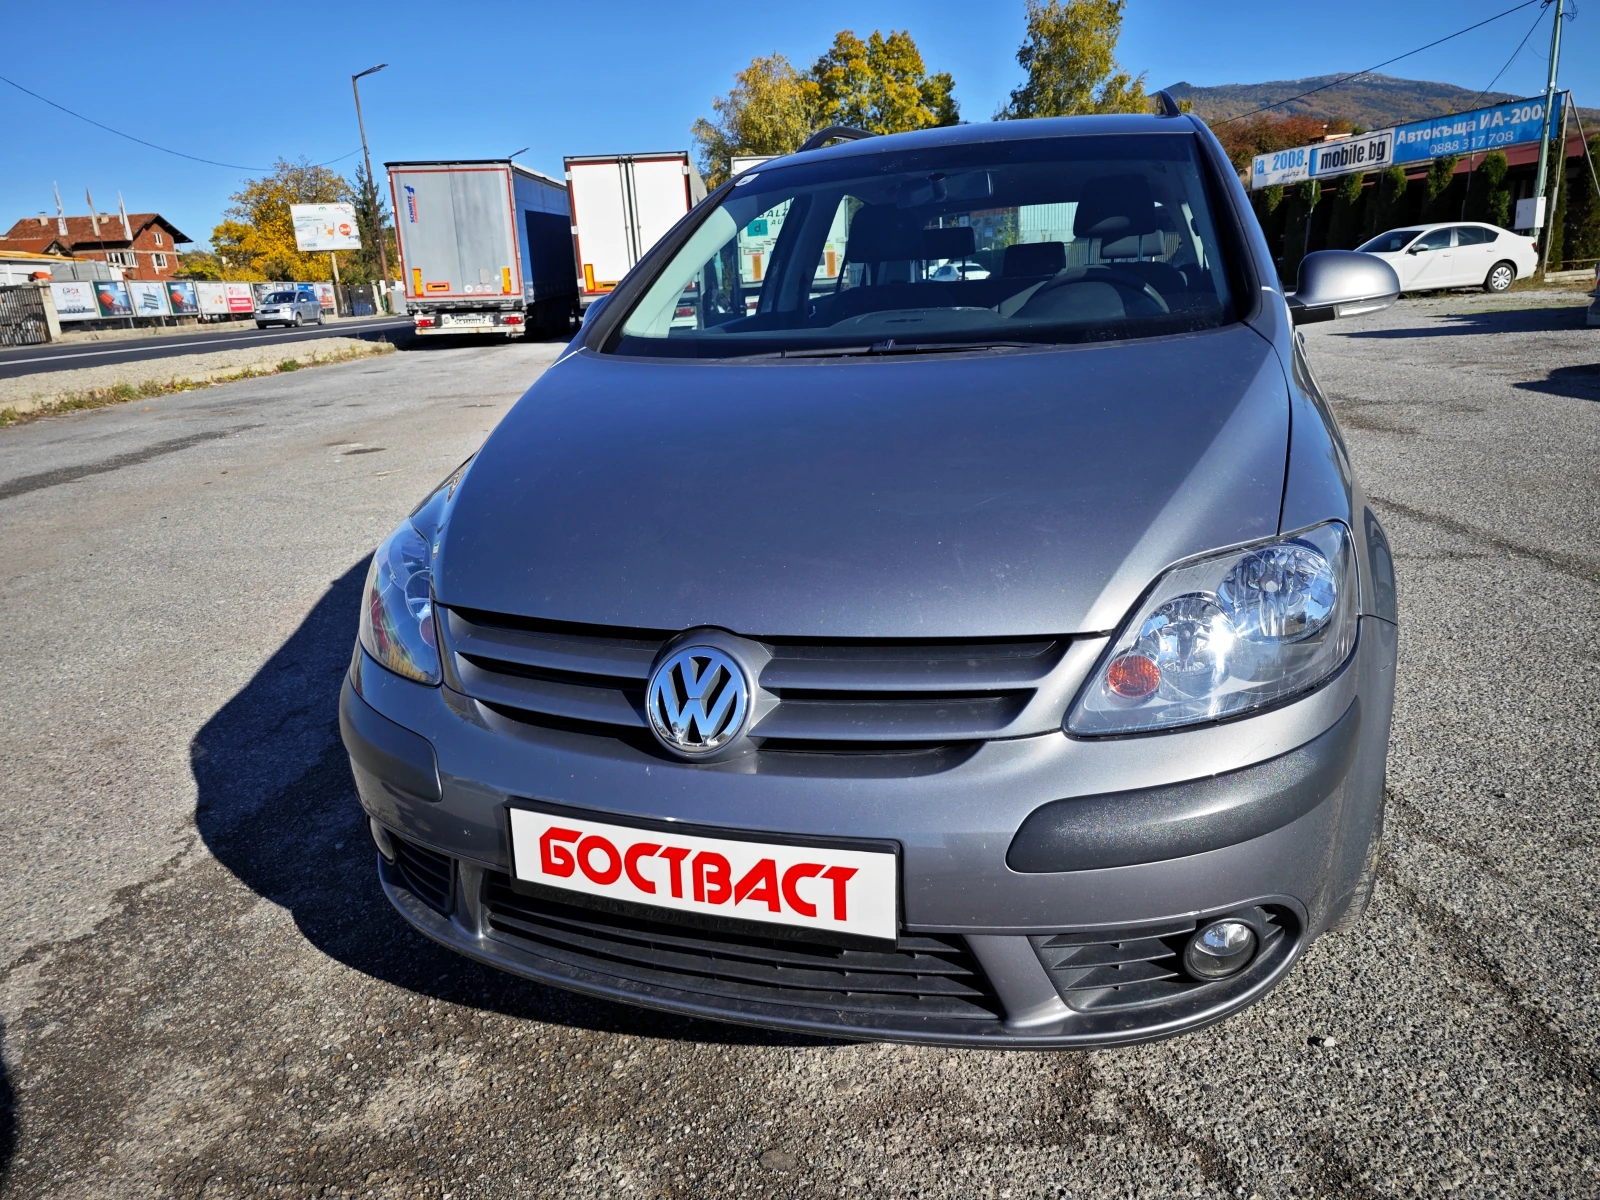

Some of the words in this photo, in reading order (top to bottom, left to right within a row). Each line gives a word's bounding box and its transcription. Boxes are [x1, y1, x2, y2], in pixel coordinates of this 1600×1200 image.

[1397, 119, 1476, 145] Автокъща
[1480, 104, 1546, 130] ИА-200
[1320, 140, 1386, 170] mobile.bg
[1429, 140, 1459, 155] 0888
[1462, 135, 1485, 150] 317
[1488, 130, 1514, 145] 708
[407, 195, 415, 223] SCHMITZ
[539, 826, 860, 922] БОСТВАСТ
